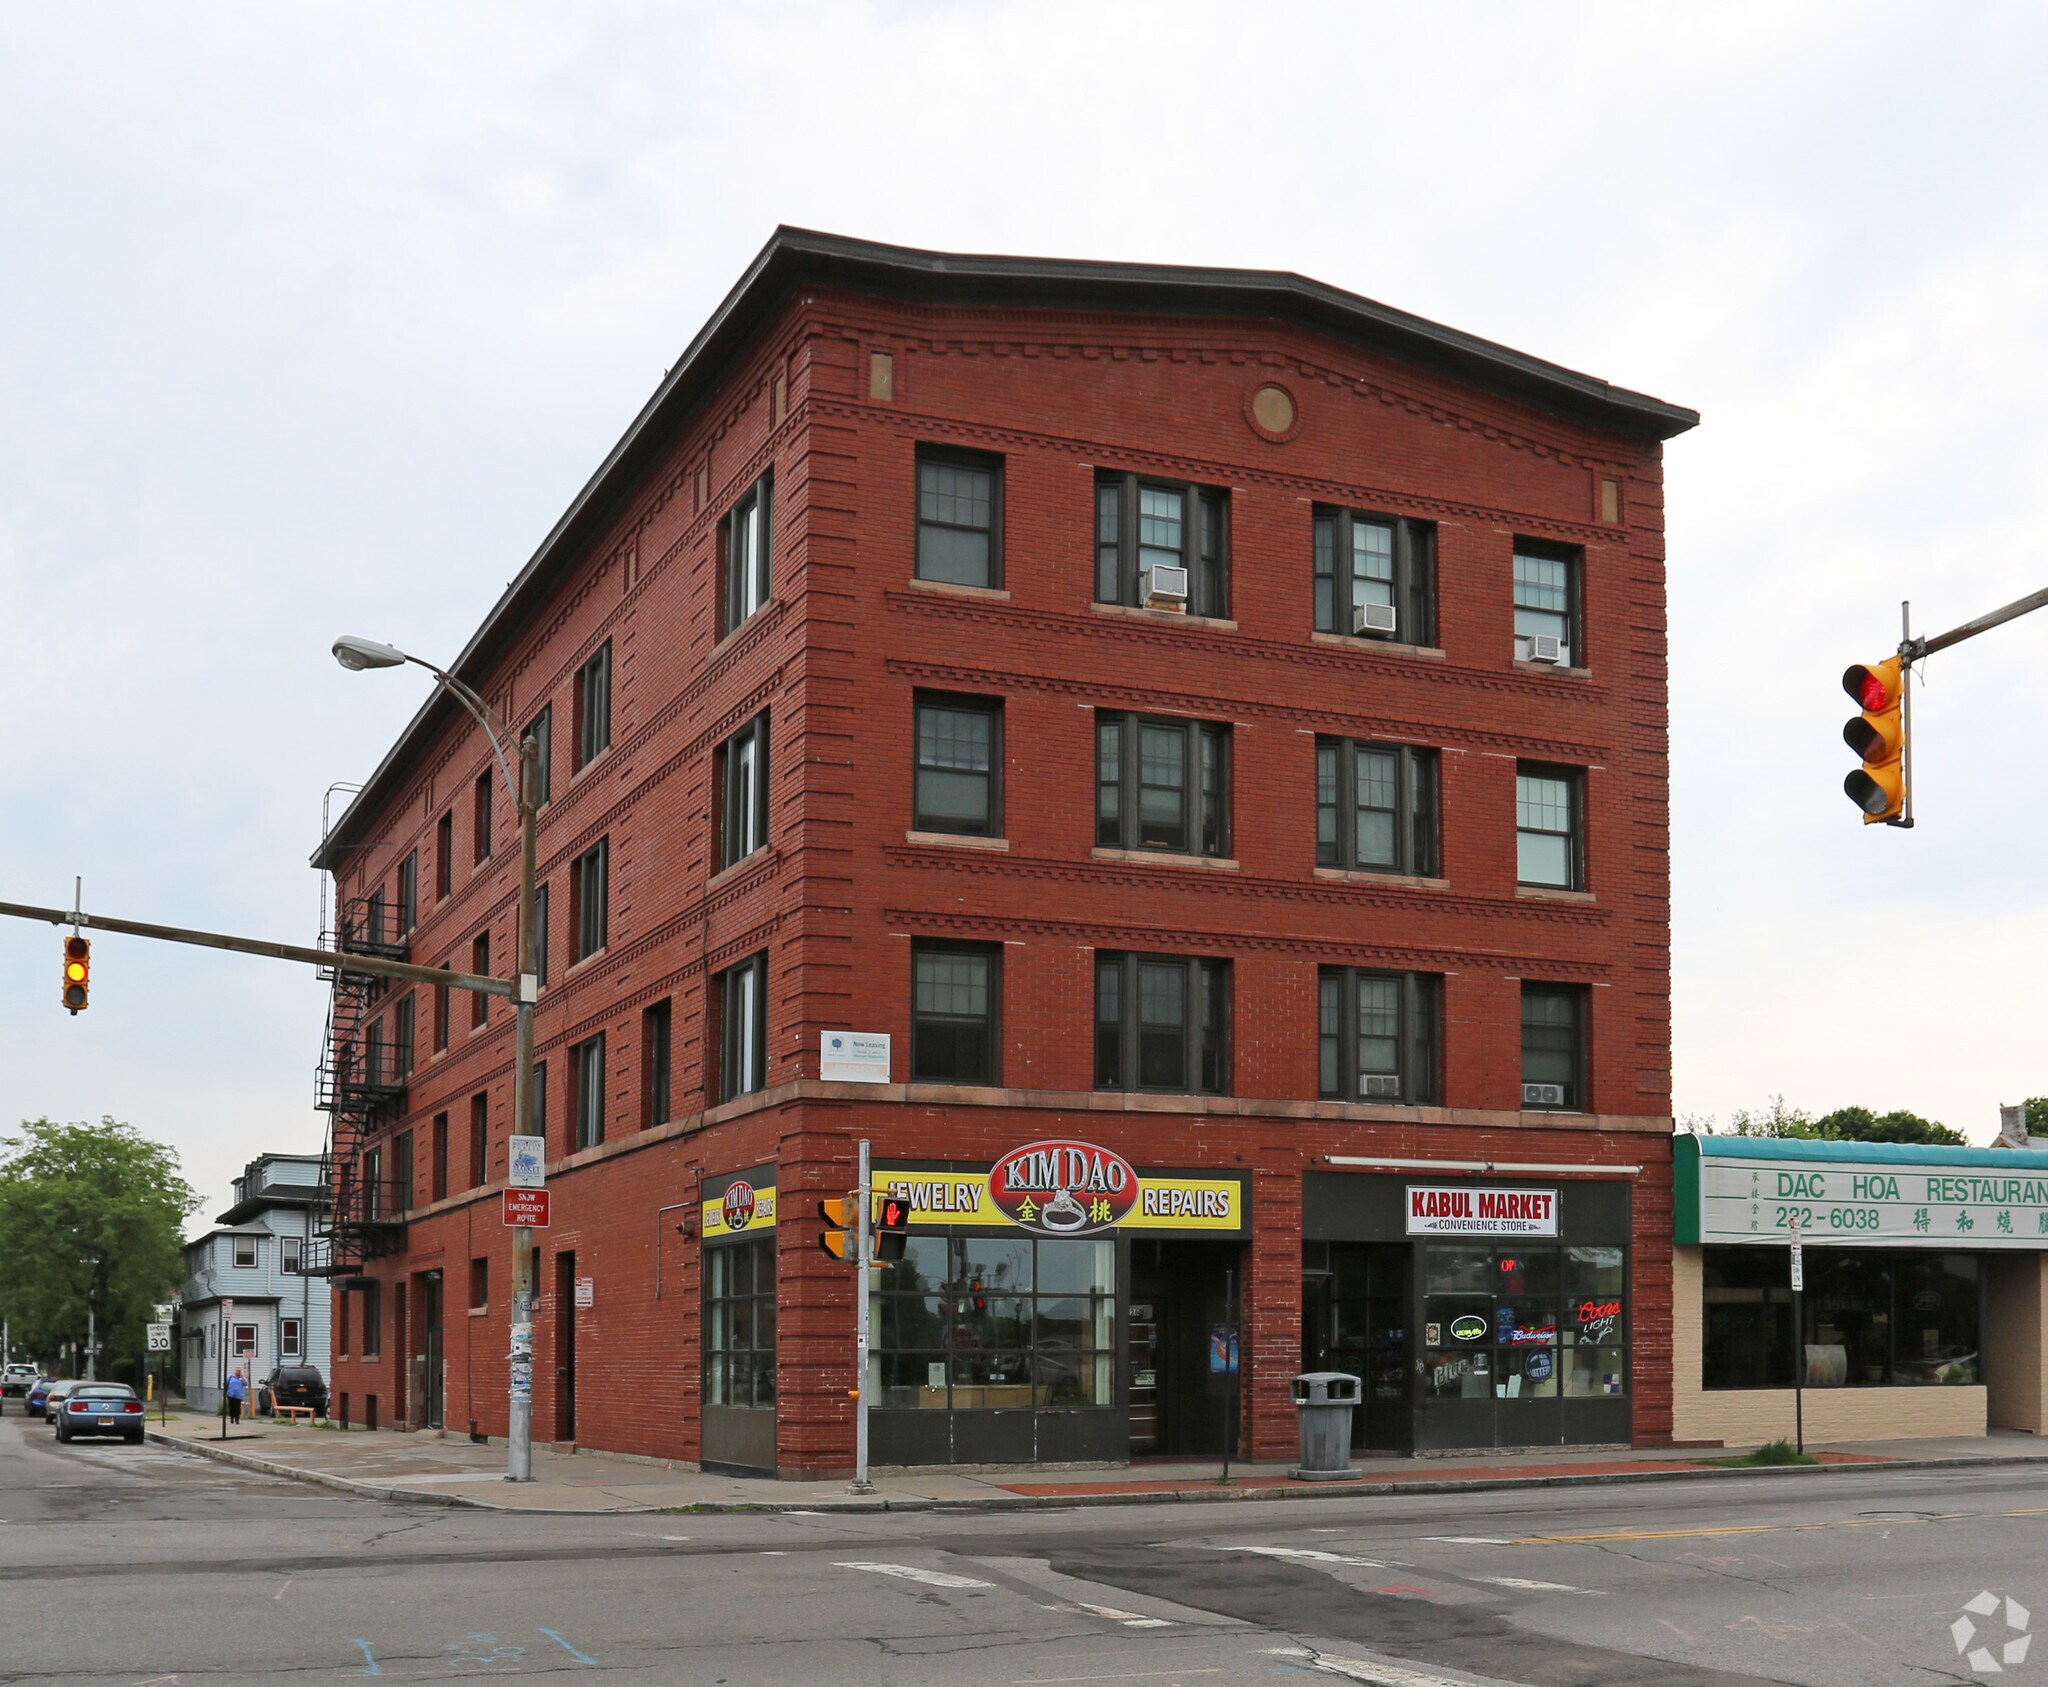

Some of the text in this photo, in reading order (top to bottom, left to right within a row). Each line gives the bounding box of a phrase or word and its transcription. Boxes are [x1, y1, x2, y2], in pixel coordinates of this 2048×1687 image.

[853, 1040, 886, 1050] Now Leasing
[1004, 1147, 1127, 1194] KIM DAO
[1777, 1173, 1825, 1199] DAC
[1853, 1175, 1901, 1201] HOA
[518, 1193, 536, 1202] SNOW
[726, 1185, 753, 1210] KIM DAO
[1143, 1188, 1230, 1217] REPAIRS
[1412, 1191, 1552, 1220] KABUL MARKET
[508, 1203, 545, 1213] EMERGENCY
[1016, 1195, 1113, 1224] 金 桃
[516, 1214, 537, 1223] ROUTE
[1439, 1219, 1527, 1232] CONVENIENCE STORE
[1579, 1302, 1621, 1322] Coors
[1584, 1315, 1615, 1333] LIGHT
[151, 1338, 169, 1348] 30
[1511, 1330, 1554, 1341] Budweiser
